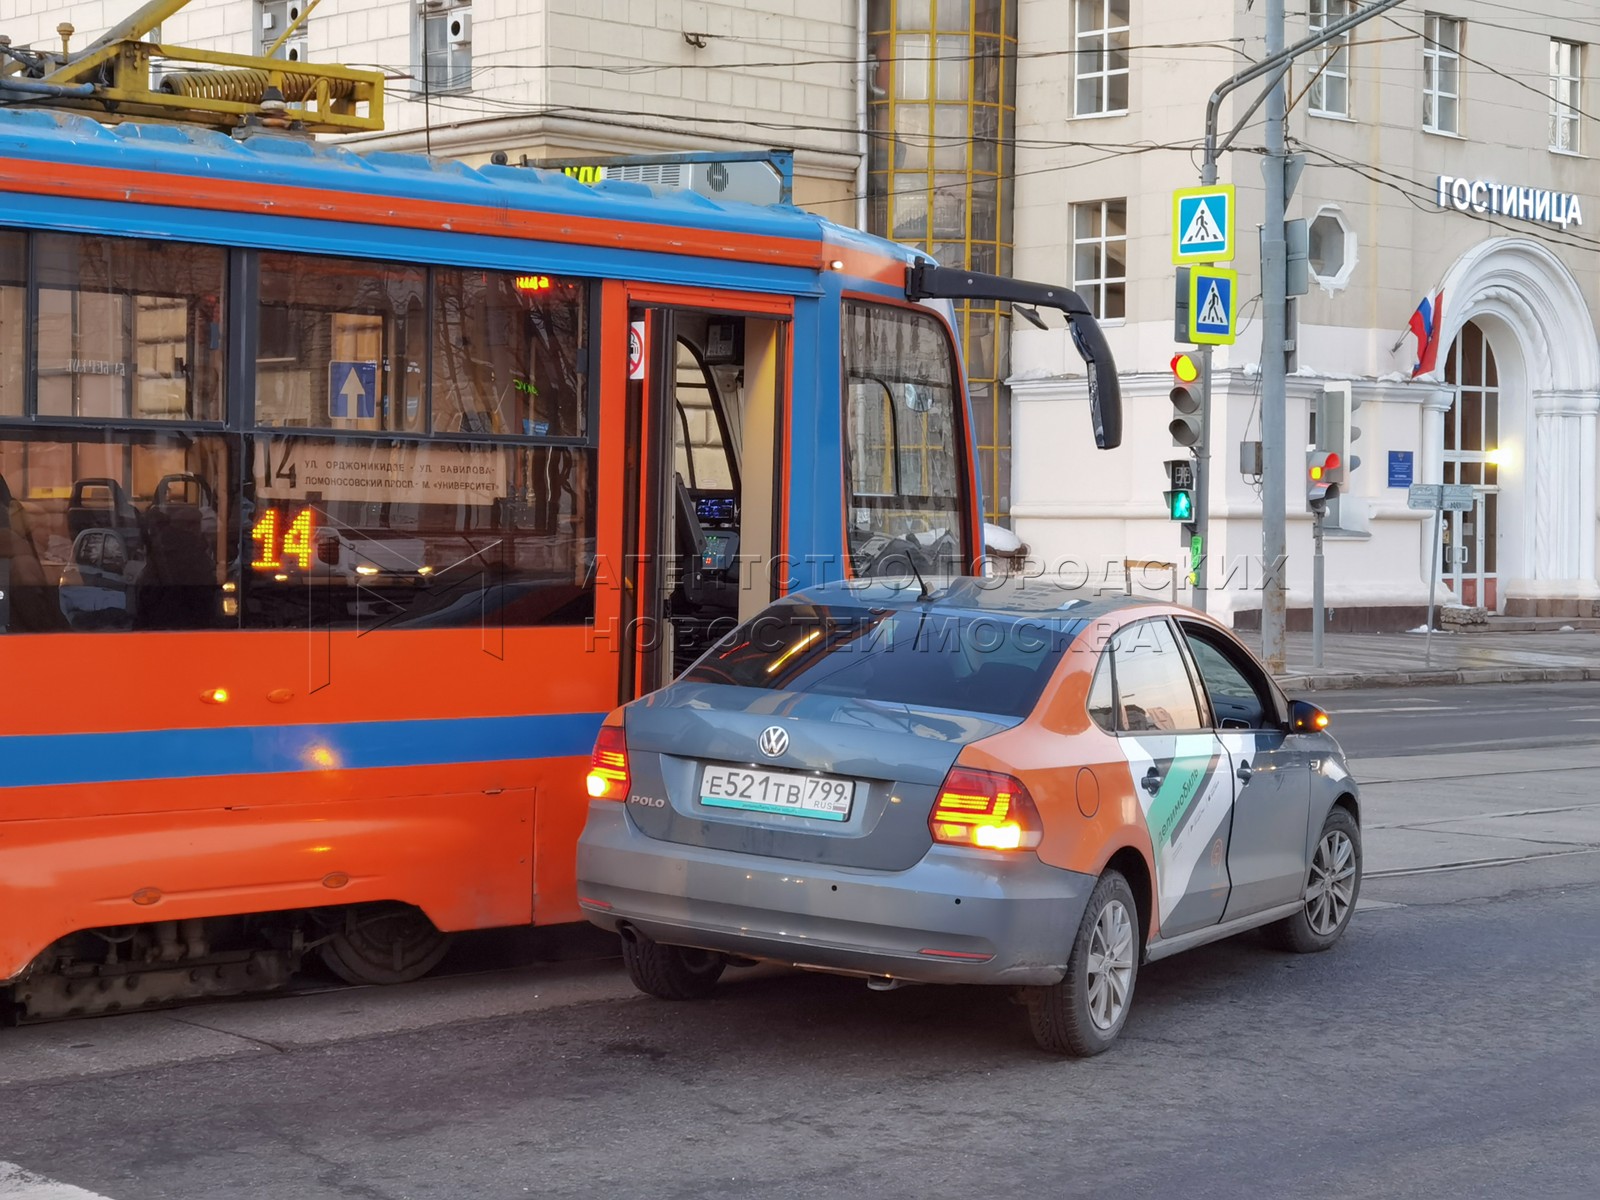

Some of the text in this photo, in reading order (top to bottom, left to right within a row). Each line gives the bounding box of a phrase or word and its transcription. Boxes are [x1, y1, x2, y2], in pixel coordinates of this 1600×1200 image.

[1437, 175, 1583, 229] ГОСТИНИЦА
[325, 460, 405, 473] ОРДЖОНИКИДЗЕ
[305, 476, 383, 488] ЛОМОНОСОВСКИЙ
[251, 510, 311, 567] 14
[808, 779, 846, 803] 799
[631, 795, 665, 808] POLO
